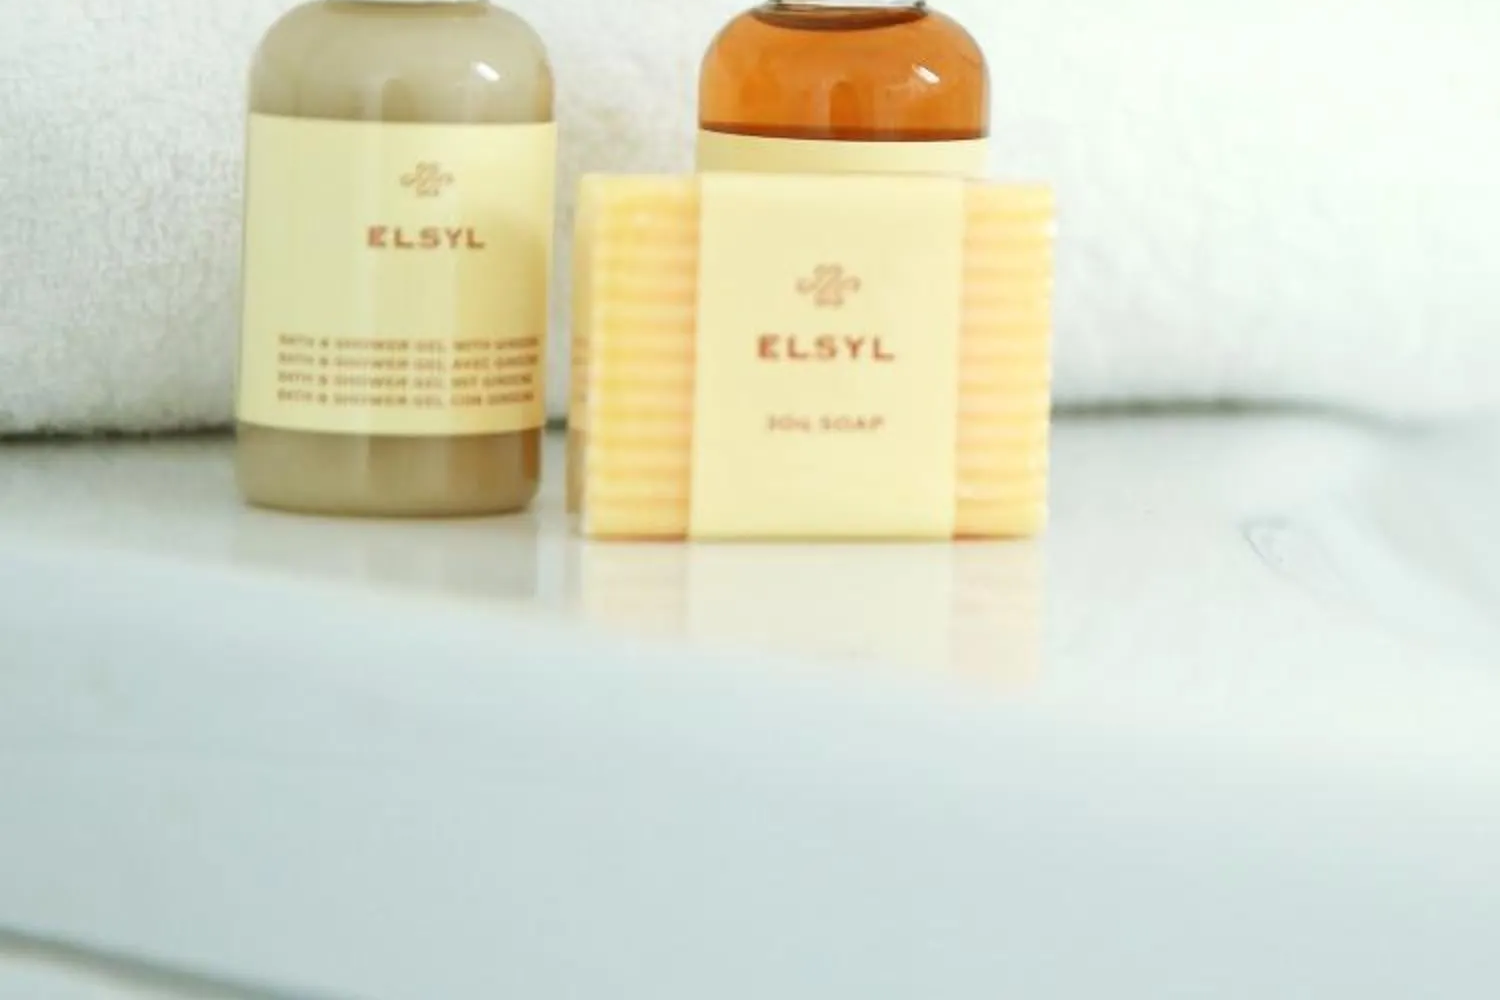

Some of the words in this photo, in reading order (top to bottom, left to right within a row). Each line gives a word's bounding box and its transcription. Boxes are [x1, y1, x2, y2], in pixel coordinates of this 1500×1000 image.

[366, 225, 486, 249] ELSYL
[335, 339, 408, 351] SHOWER
[414, 340, 443, 352] GEL
[757, 334, 895, 361] ELSYL
[334, 357, 408, 370] SHOWER
[414, 358, 443, 371] GEL
[334, 375, 407, 388] SHOWER
[414, 376, 442, 389] GEL
[333, 393, 407, 406] SHOWER
[414, 394, 442, 407] GEL
[819, 413, 885, 431] SOAP
